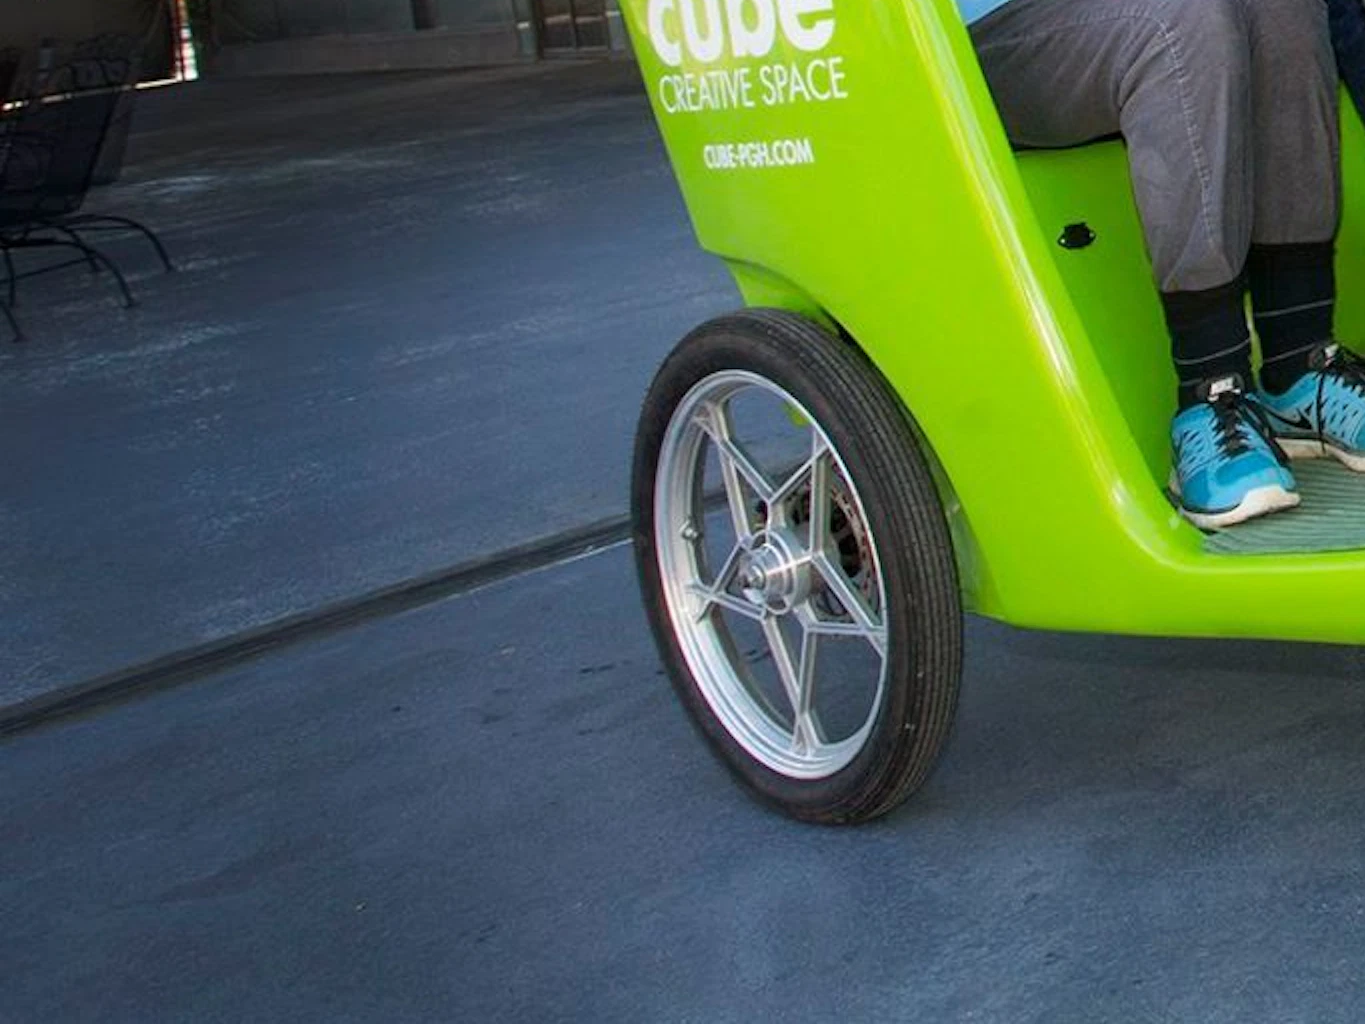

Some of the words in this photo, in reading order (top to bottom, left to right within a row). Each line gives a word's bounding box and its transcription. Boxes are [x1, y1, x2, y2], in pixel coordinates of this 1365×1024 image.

[658, 66, 756, 114] CREATIVE
[760, 56, 848, 107] SPACE
[703, 138, 815, 170] CUBE-PGH.COM
